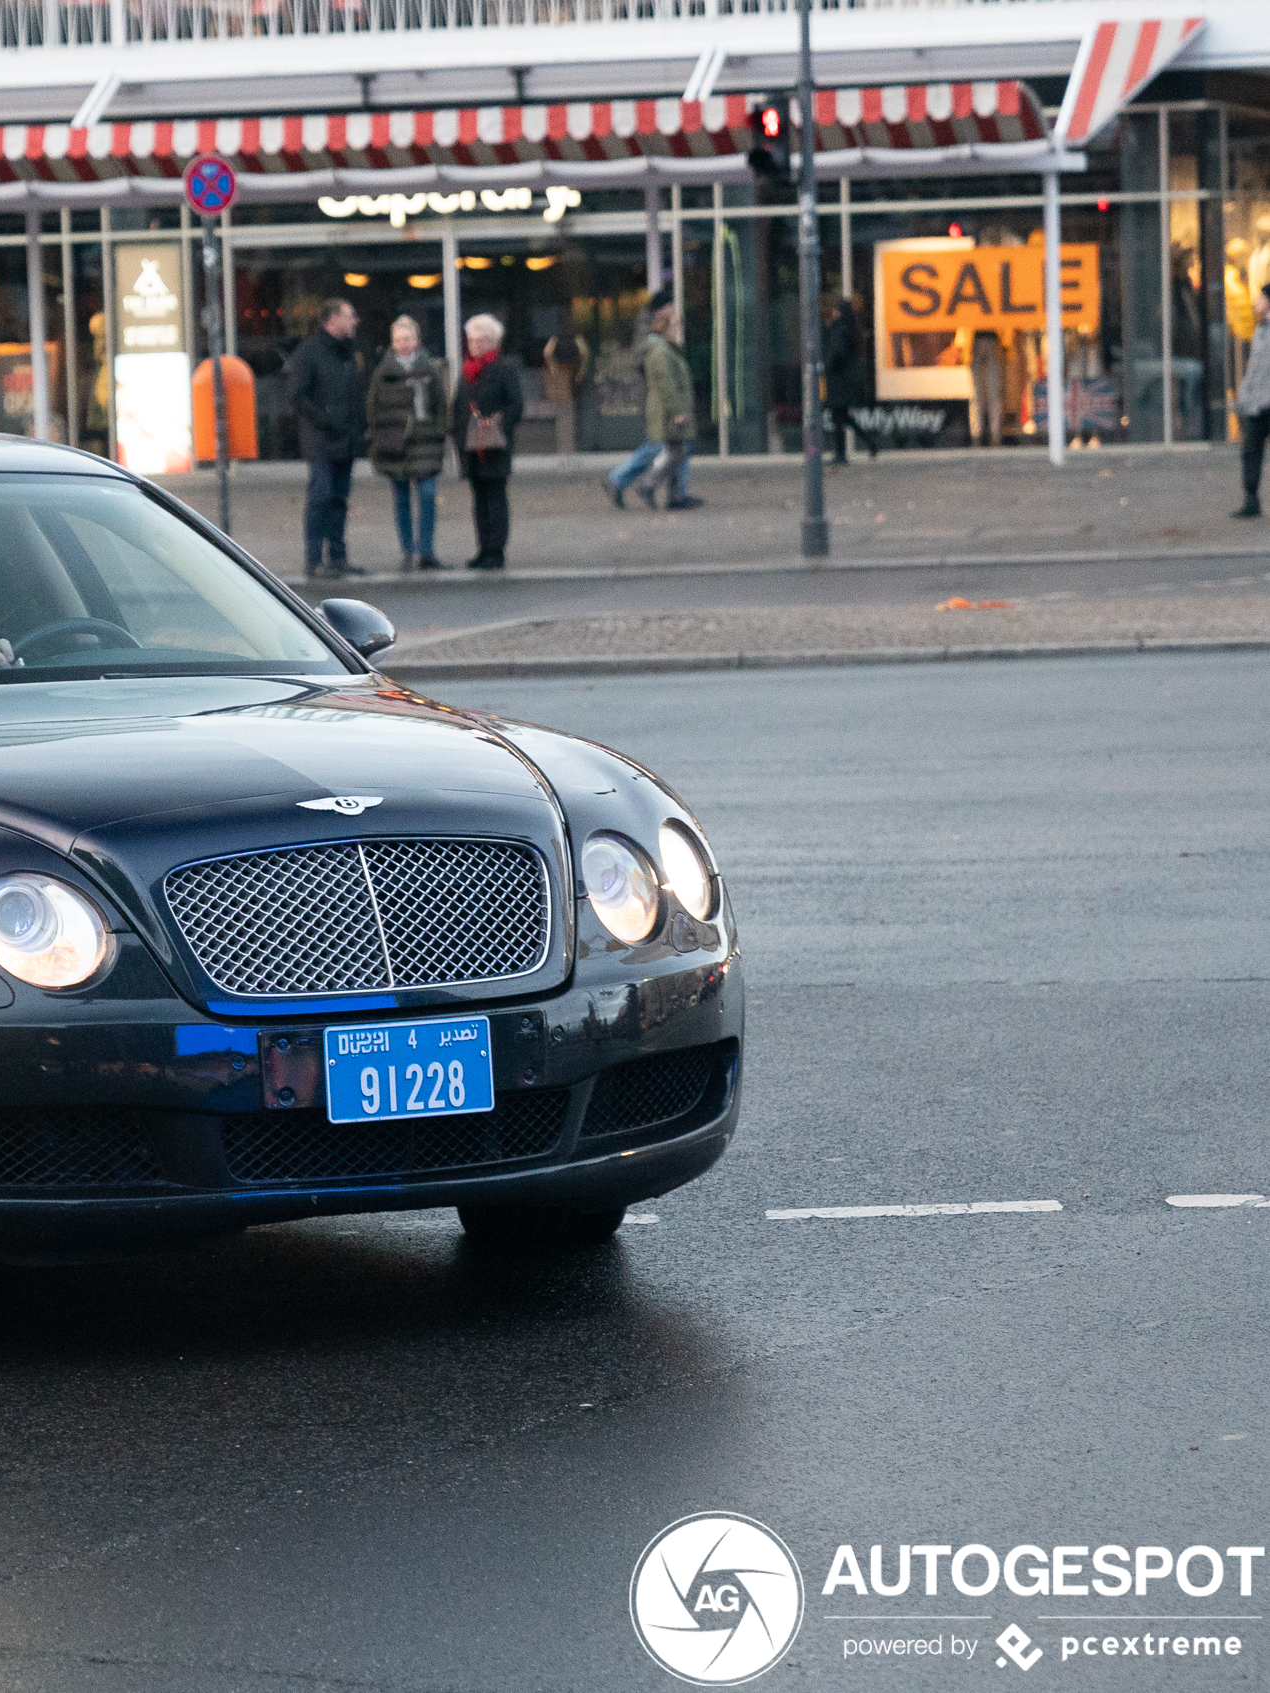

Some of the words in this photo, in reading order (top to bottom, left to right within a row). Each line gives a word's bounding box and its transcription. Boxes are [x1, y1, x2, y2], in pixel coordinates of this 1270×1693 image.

[899, 259, 1083, 317] SALE
[407, 1029, 418, 1050] 4
[438, 1023, 479, 1047] تصدير
[360, 1059, 466, 1114] 91228
